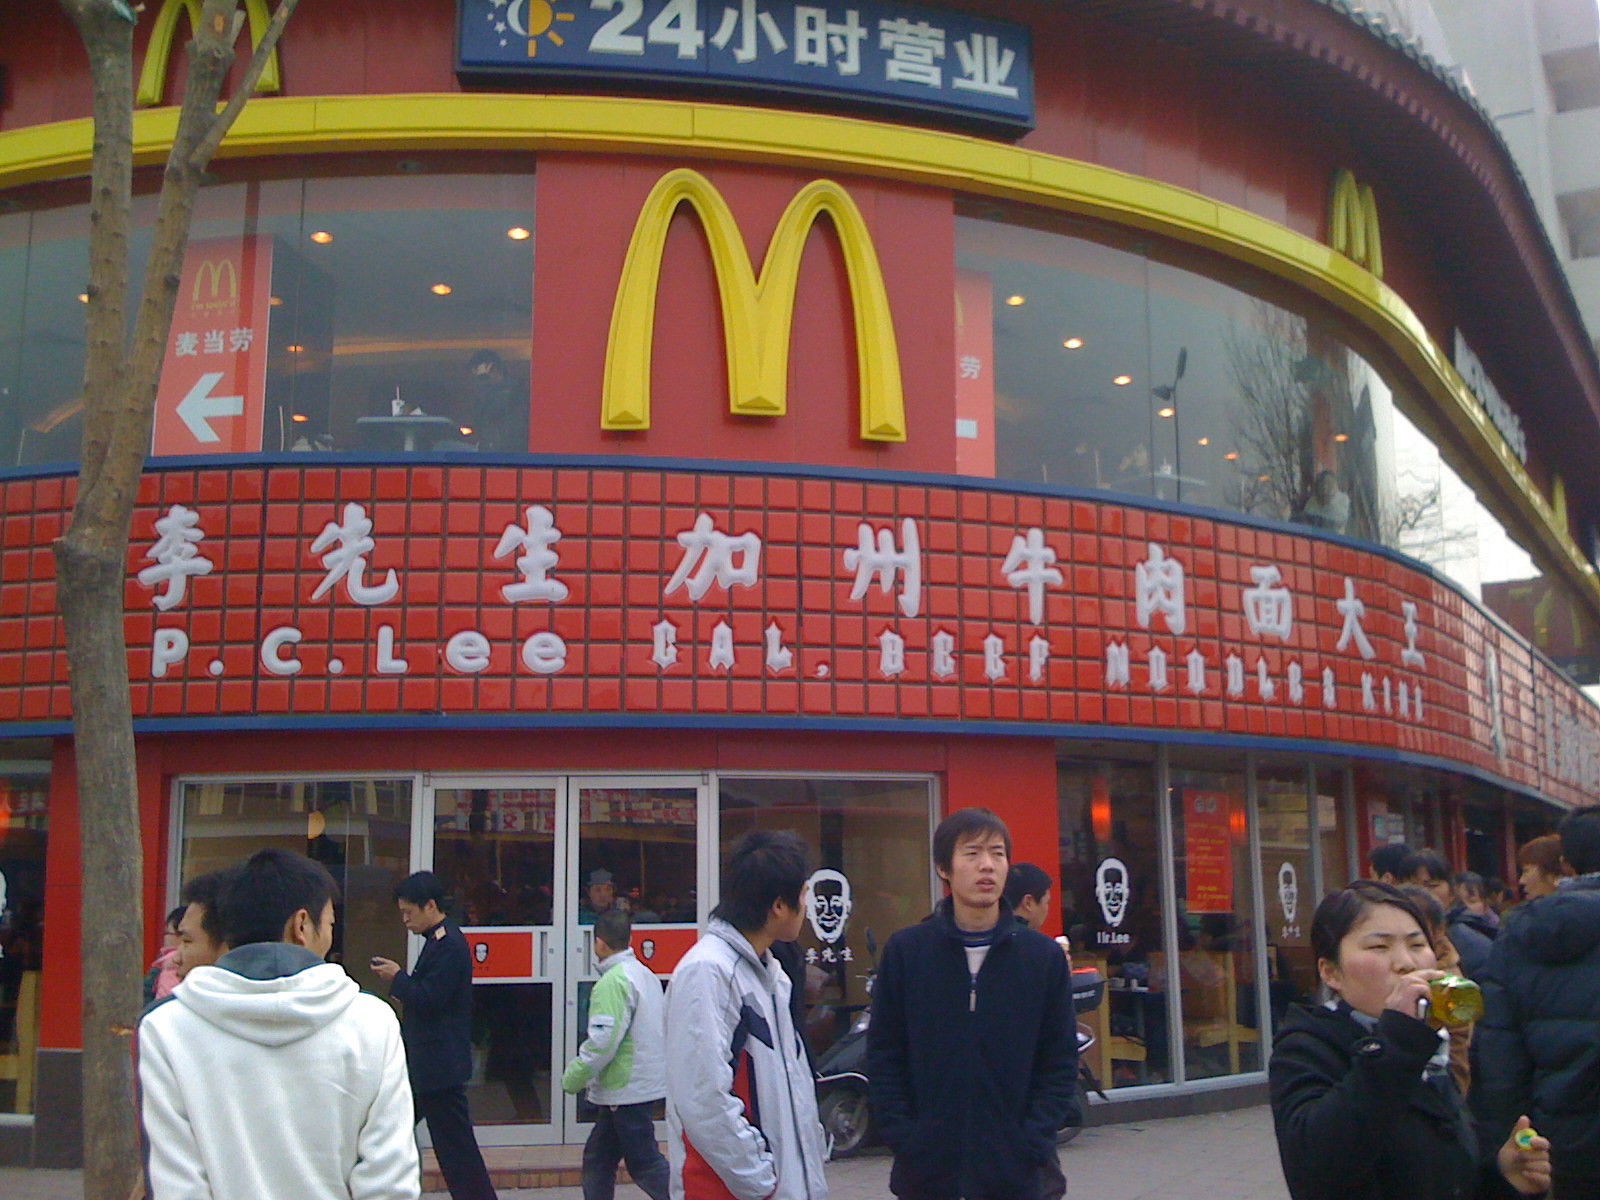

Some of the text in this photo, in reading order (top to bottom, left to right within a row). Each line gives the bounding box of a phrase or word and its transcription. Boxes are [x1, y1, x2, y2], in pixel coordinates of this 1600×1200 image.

[588, 0, 1019, 99] 24小时营业
[175, 327, 253, 358] 麦当劳
[804, 946, 854, 964] 李先生
